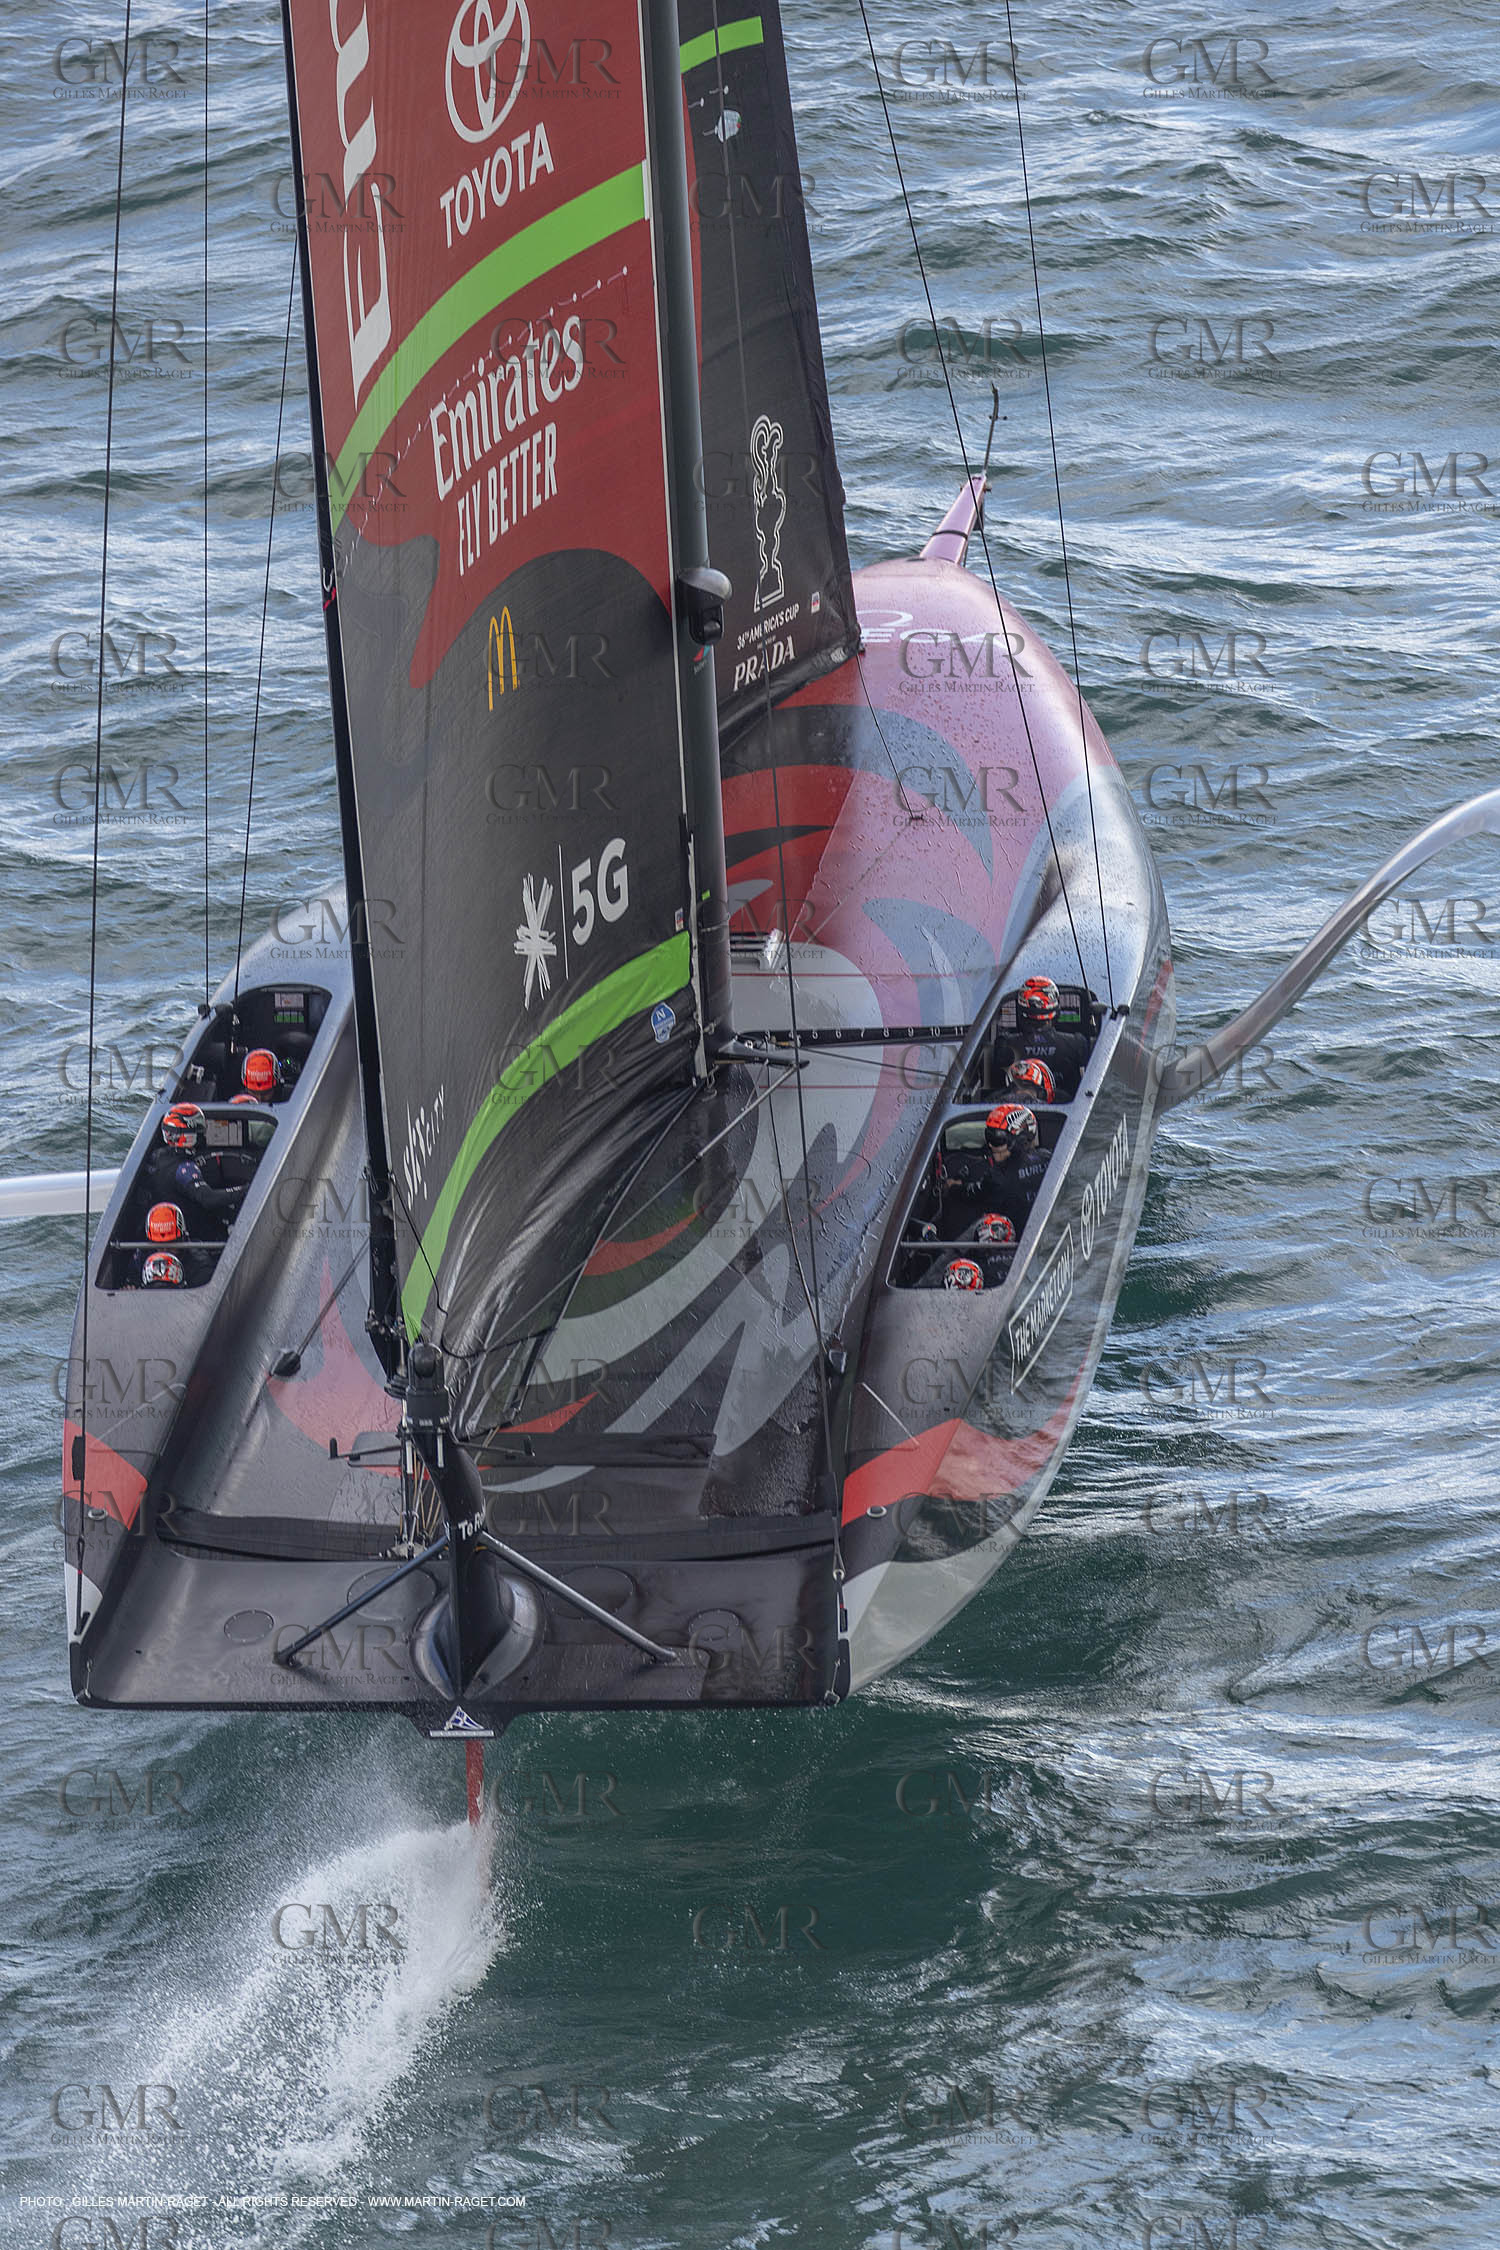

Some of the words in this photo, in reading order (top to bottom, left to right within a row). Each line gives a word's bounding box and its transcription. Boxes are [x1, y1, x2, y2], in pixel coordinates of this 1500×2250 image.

[439, 121, 555, 249] TOYOTA
[430, 314, 584, 501] Emirates
[457, 478, 481, 577] FLY
[487, 421, 558, 546] BETTER
[733, 634, 796, 692] PRADA
[572, 837, 629, 946] 5G
[1095, 1112, 1129, 1228] TOYOTA
